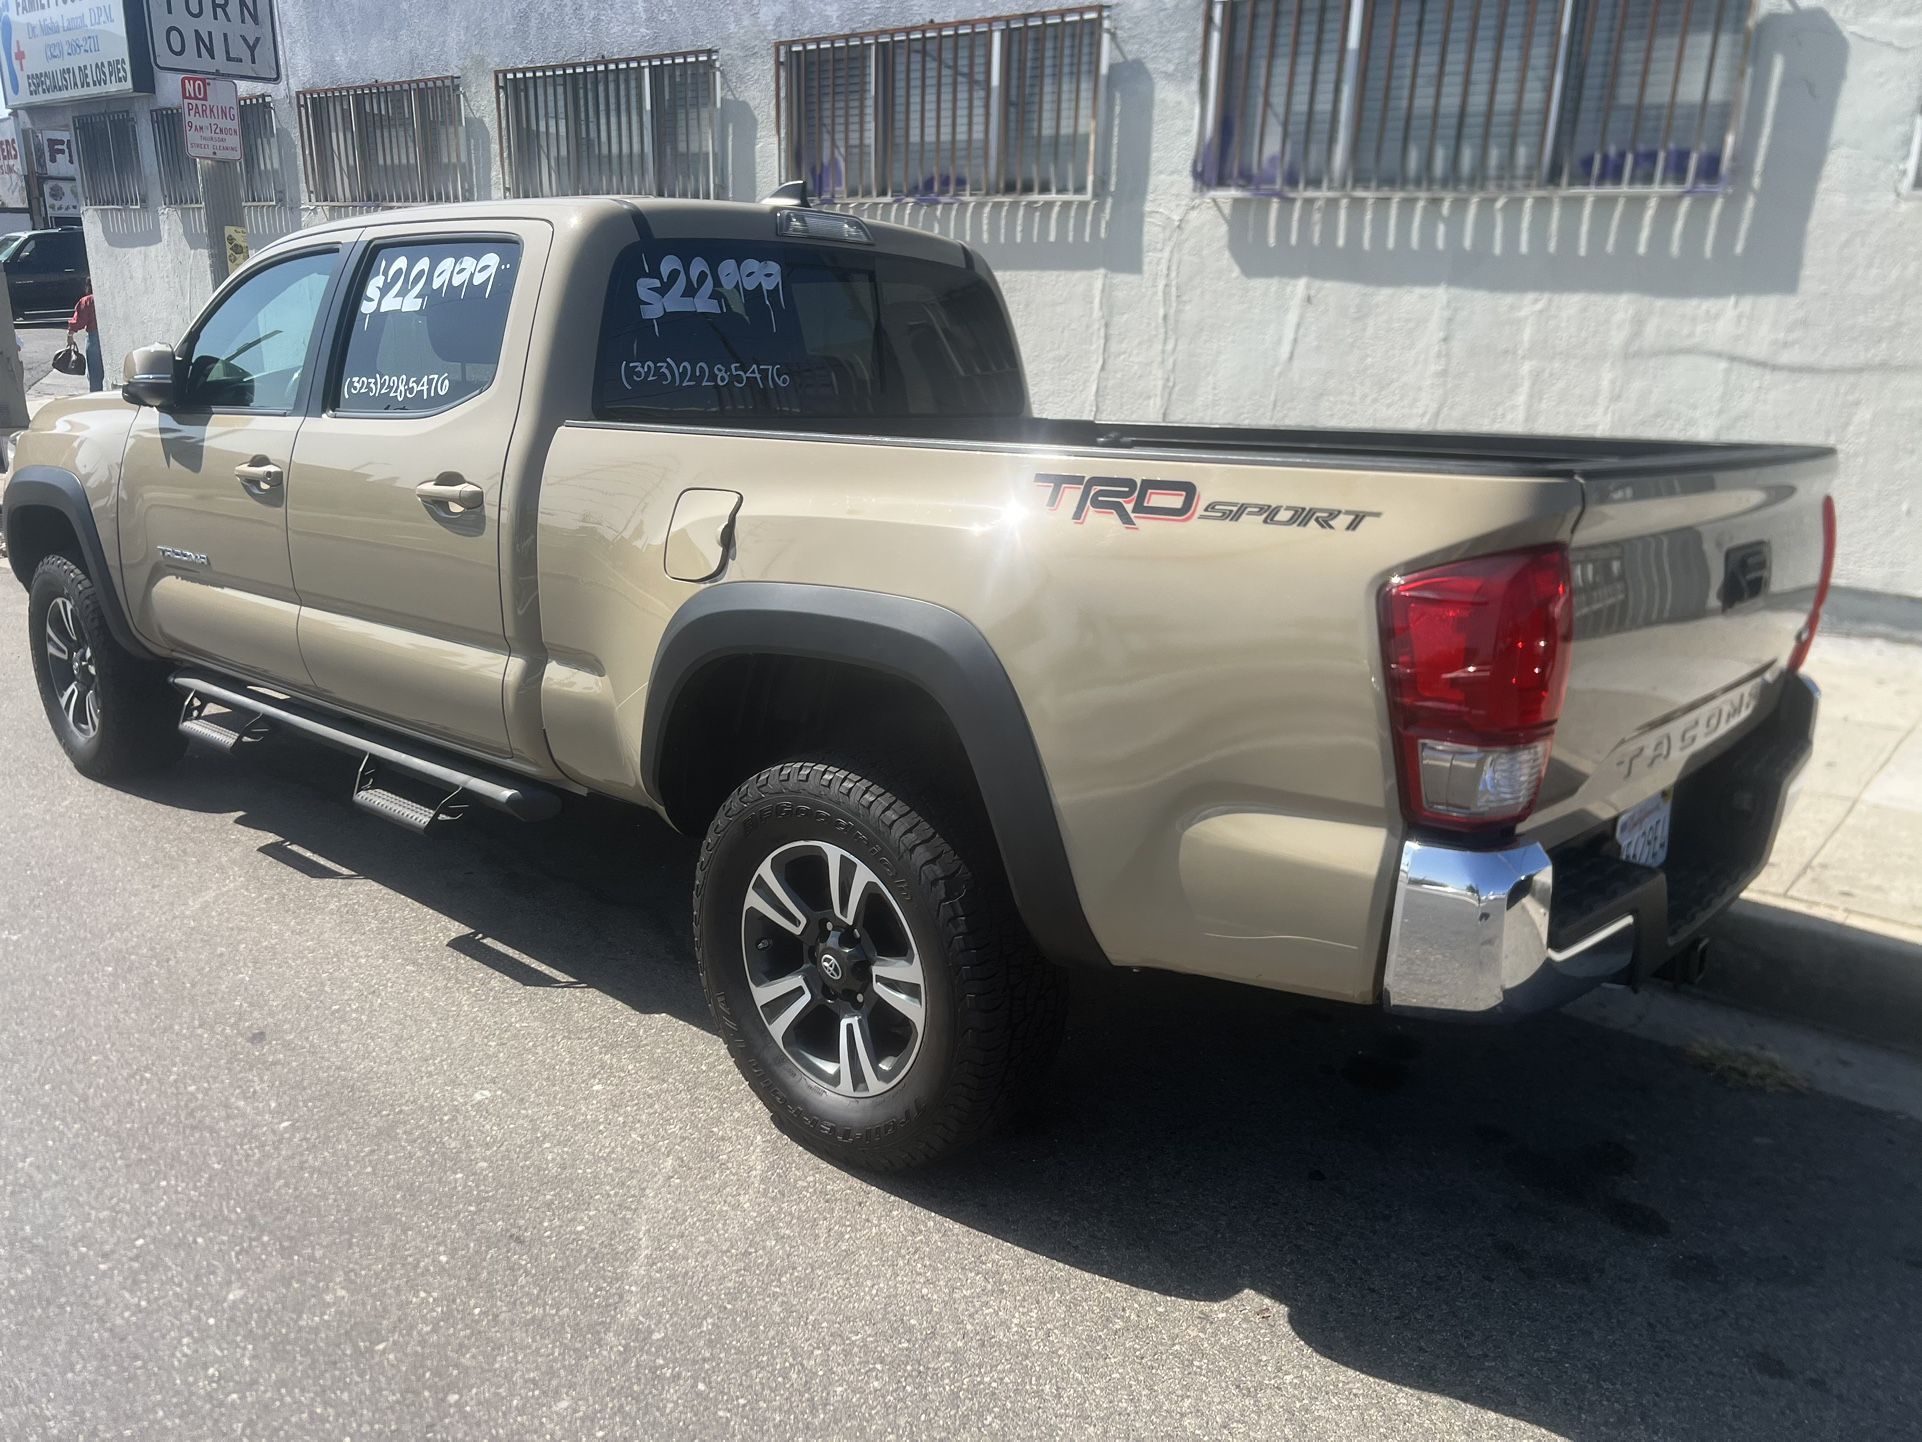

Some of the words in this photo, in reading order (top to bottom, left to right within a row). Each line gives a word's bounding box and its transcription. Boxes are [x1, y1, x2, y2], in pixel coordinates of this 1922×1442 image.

[165, 25, 262, 65] ONLY
[26, 67, 79, 96] ESPECIALISTA
[78, 64, 90, 89] DE
[90, 60, 107, 87] LOS
[107, 57, 128, 85] PIES
[184, 79, 205, 98] NO
[187, 102, 236, 122] PARKING
[0, 138, 19, 161] ERS
[212, 144, 238, 153] CLEANING
[1032, 473, 1200, 531] TRD
[1198, 501, 1384, 532] SPORT
